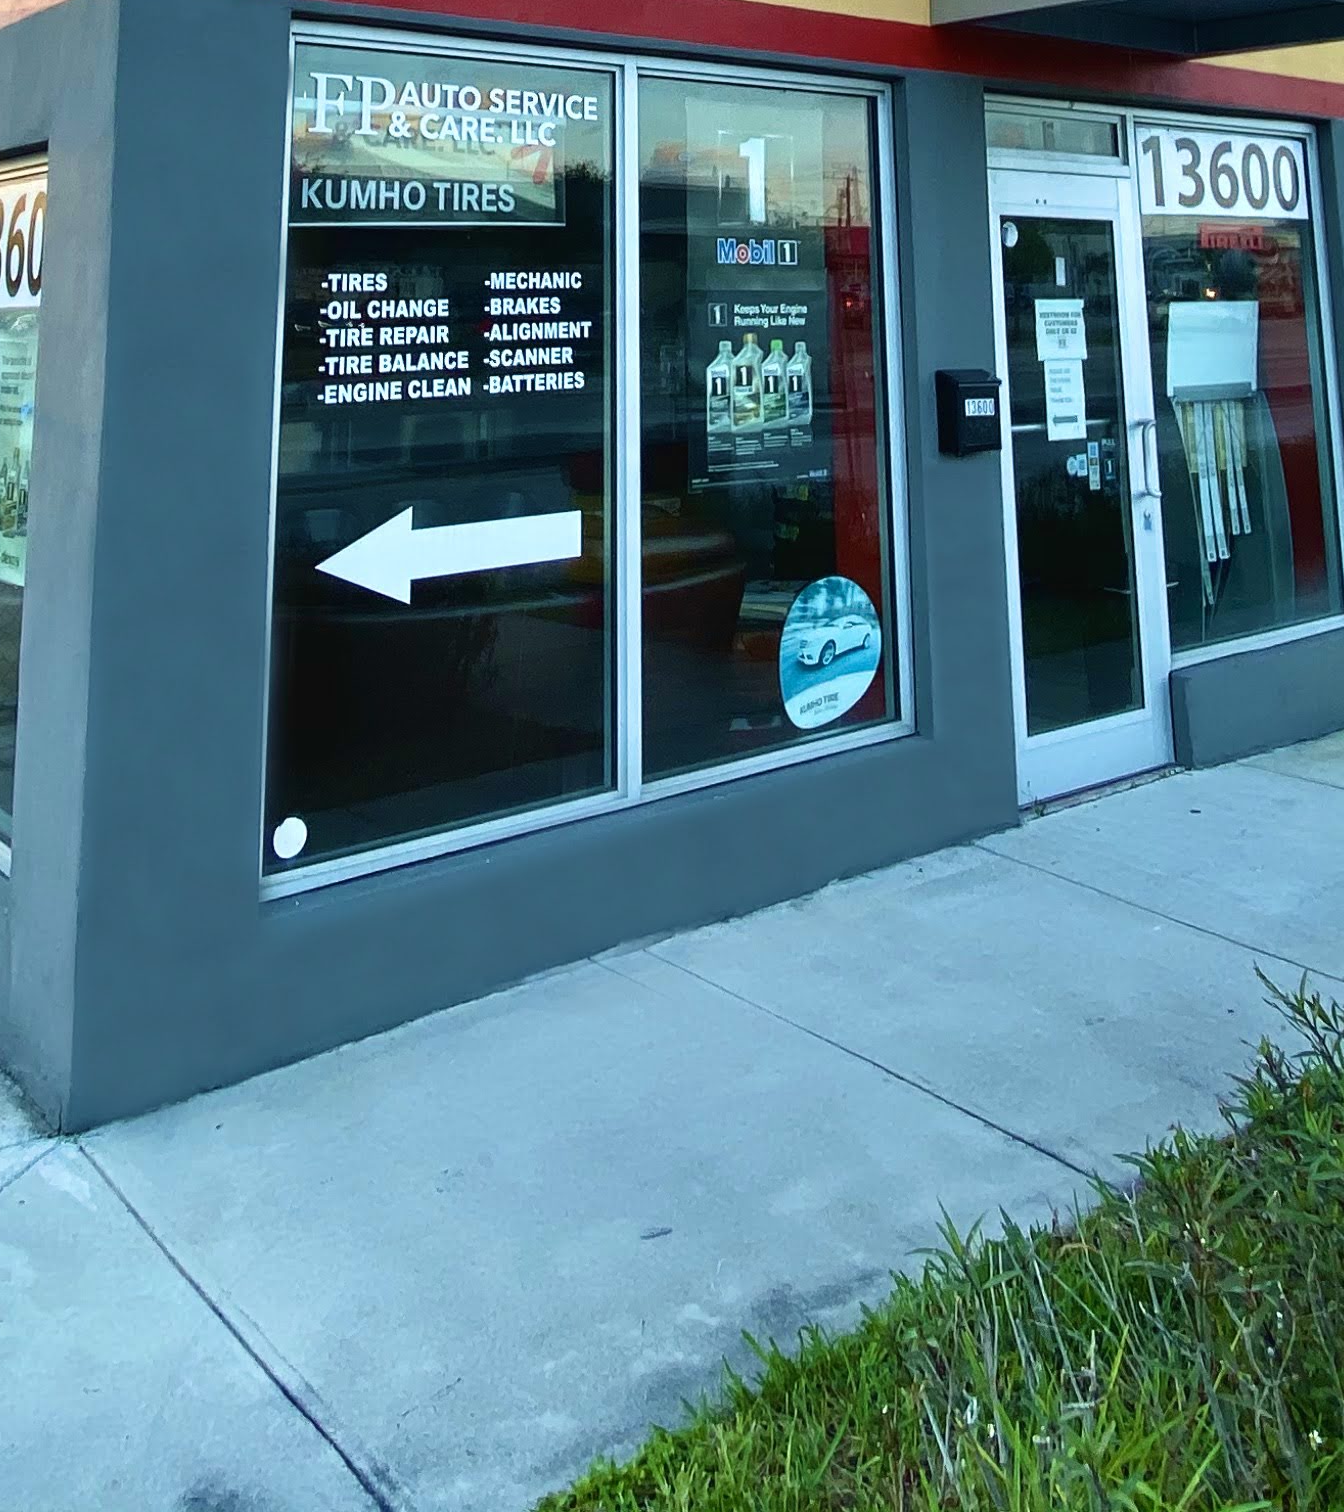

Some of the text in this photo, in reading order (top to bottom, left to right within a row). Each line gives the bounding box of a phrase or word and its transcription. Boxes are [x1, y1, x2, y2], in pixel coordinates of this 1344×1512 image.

[308, 72, 599, 136] FP AUTO SERVICE
[389, 111, 412, 138] &
[511, 119, 556, 147] LLC
[739, 137, 766, 224] 1
[1141, 135, 1300, 212] 13600
[301, 178, 516, 213] KUMHO TIRES
[717, 238, 775, 265] Mobil
[484, 272, 582, 290] -MECHANIC
[367, 299, 449, 319] CHANGE
[484, 297, 561, 315] -BRAKES
[483, 321, 592, 341] -ALIGNMENT
[734, 315, 769, 328] Running
[379, 325, 449, 346] REPAIR
[378, 351, 469, 374] BALANCE
[483, 347, 574, 368] -SCANNER
[407, 377, 472, 400] CLEAN
[483, 372, 585, 394] -BATTERIES
[967, 400, 994, 415] 13600
